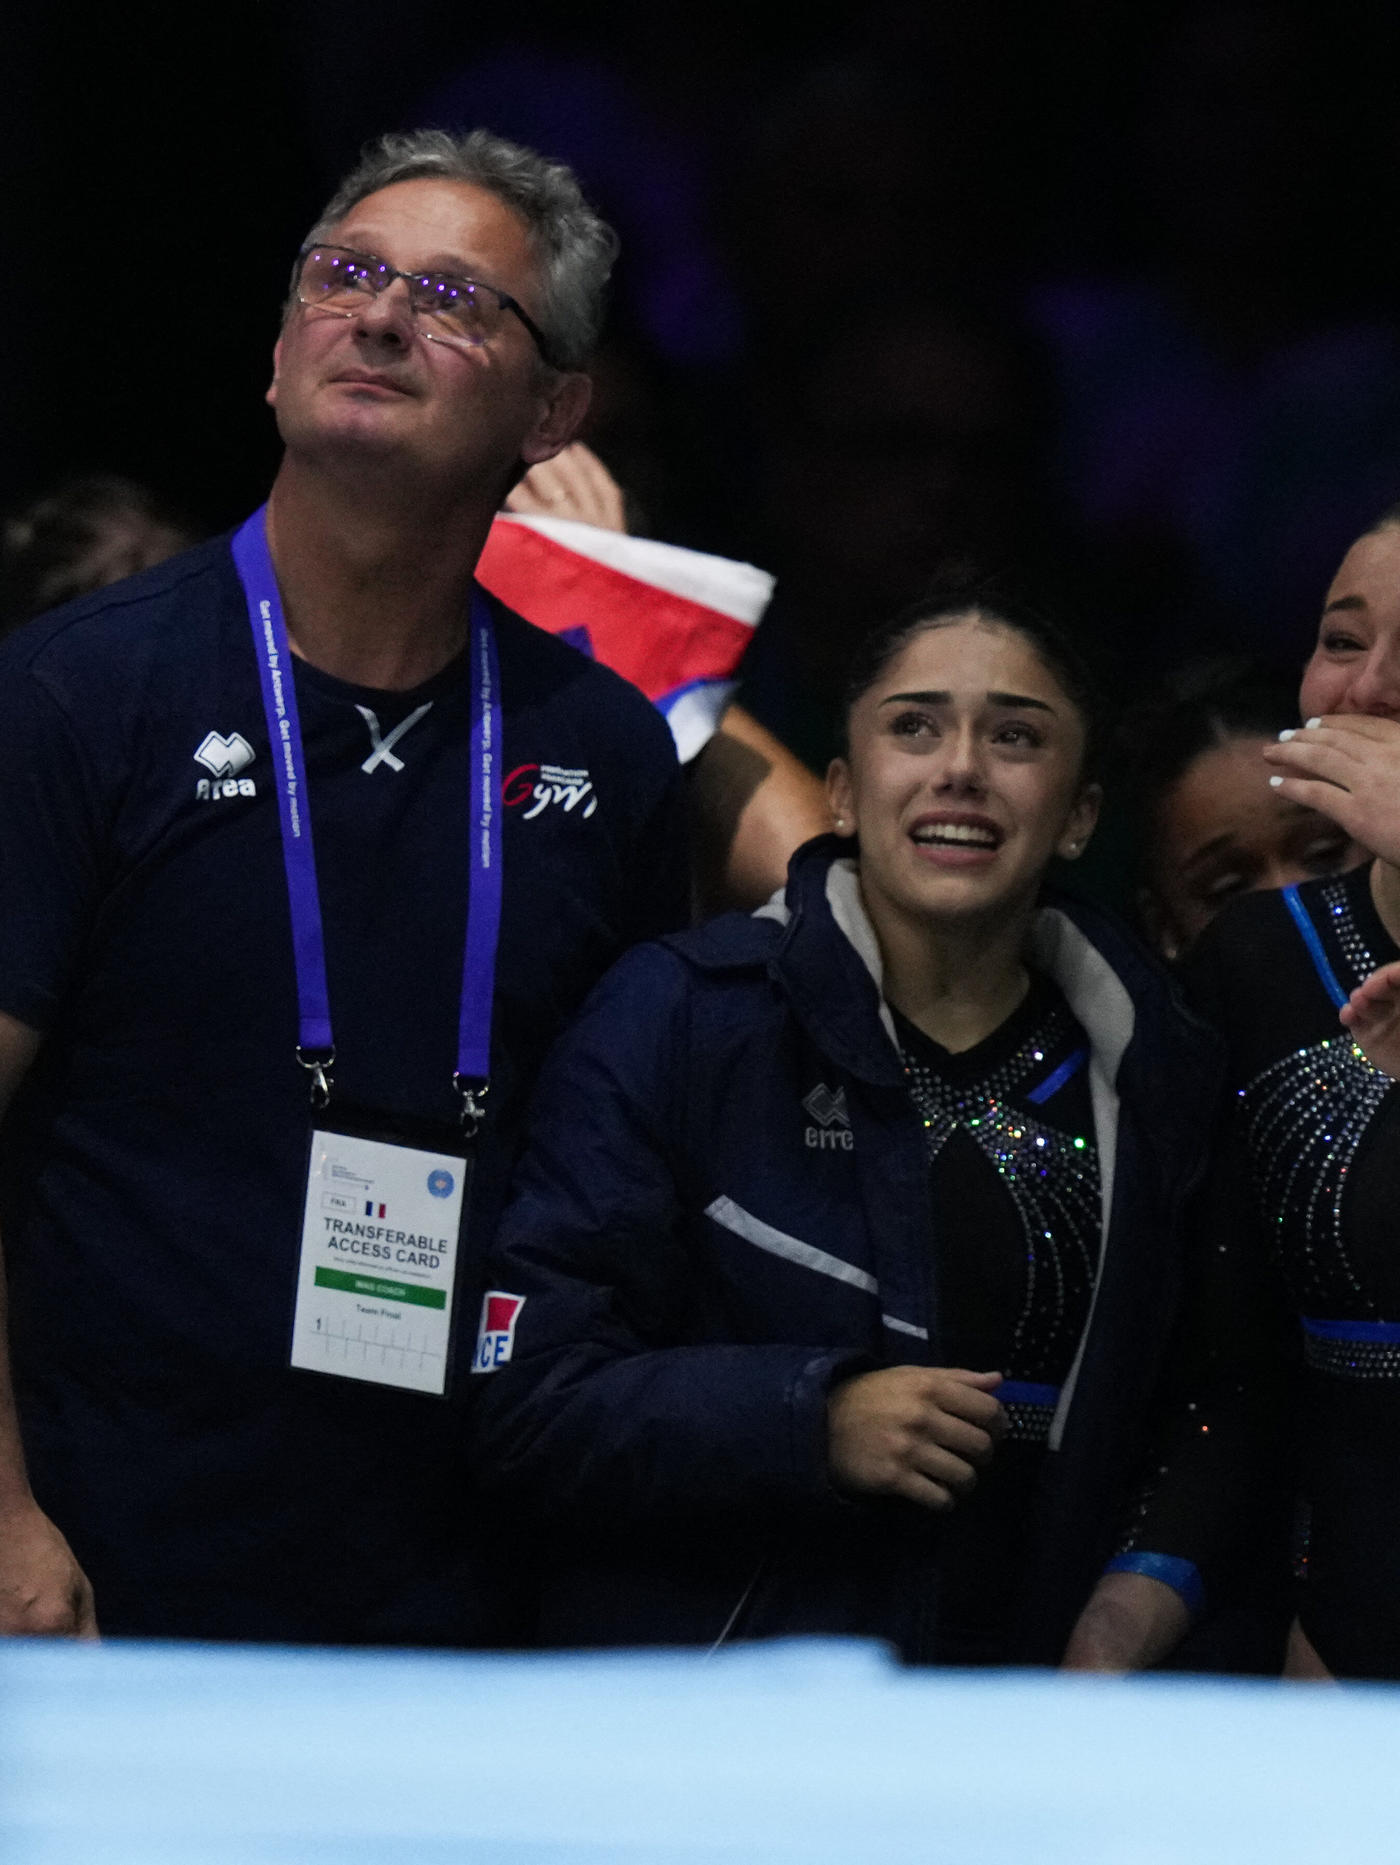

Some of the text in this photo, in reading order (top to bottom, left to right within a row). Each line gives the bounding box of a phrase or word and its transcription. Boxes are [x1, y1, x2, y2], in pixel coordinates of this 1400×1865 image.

[324, 1217, 448, 1254] TRANSFERABLE
[328, 1236, 391, 1260] ACCESS
[396, 1249, 440, 1269] CARD
